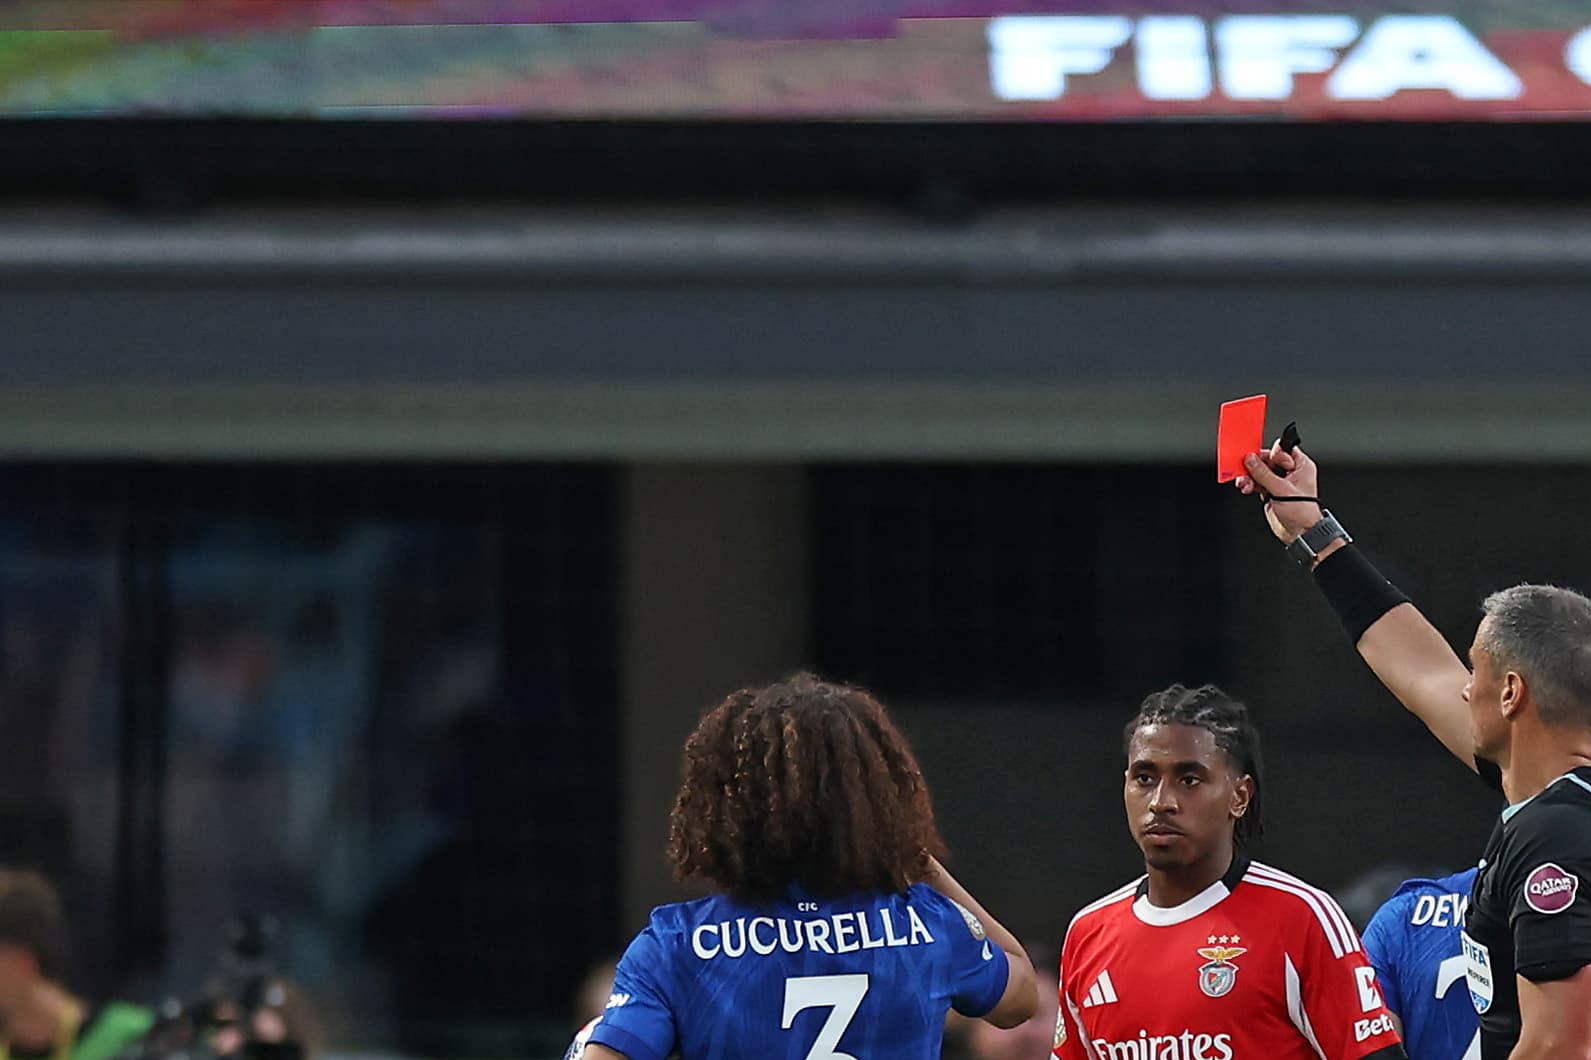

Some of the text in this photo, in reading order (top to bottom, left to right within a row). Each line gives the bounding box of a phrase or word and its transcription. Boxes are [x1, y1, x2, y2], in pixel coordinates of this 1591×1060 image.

[986, 12, 1525, 101] FIFA
[1530, 877, 1573, 896] QATAR
[692, 905, 936, 961] CUCURELLA
